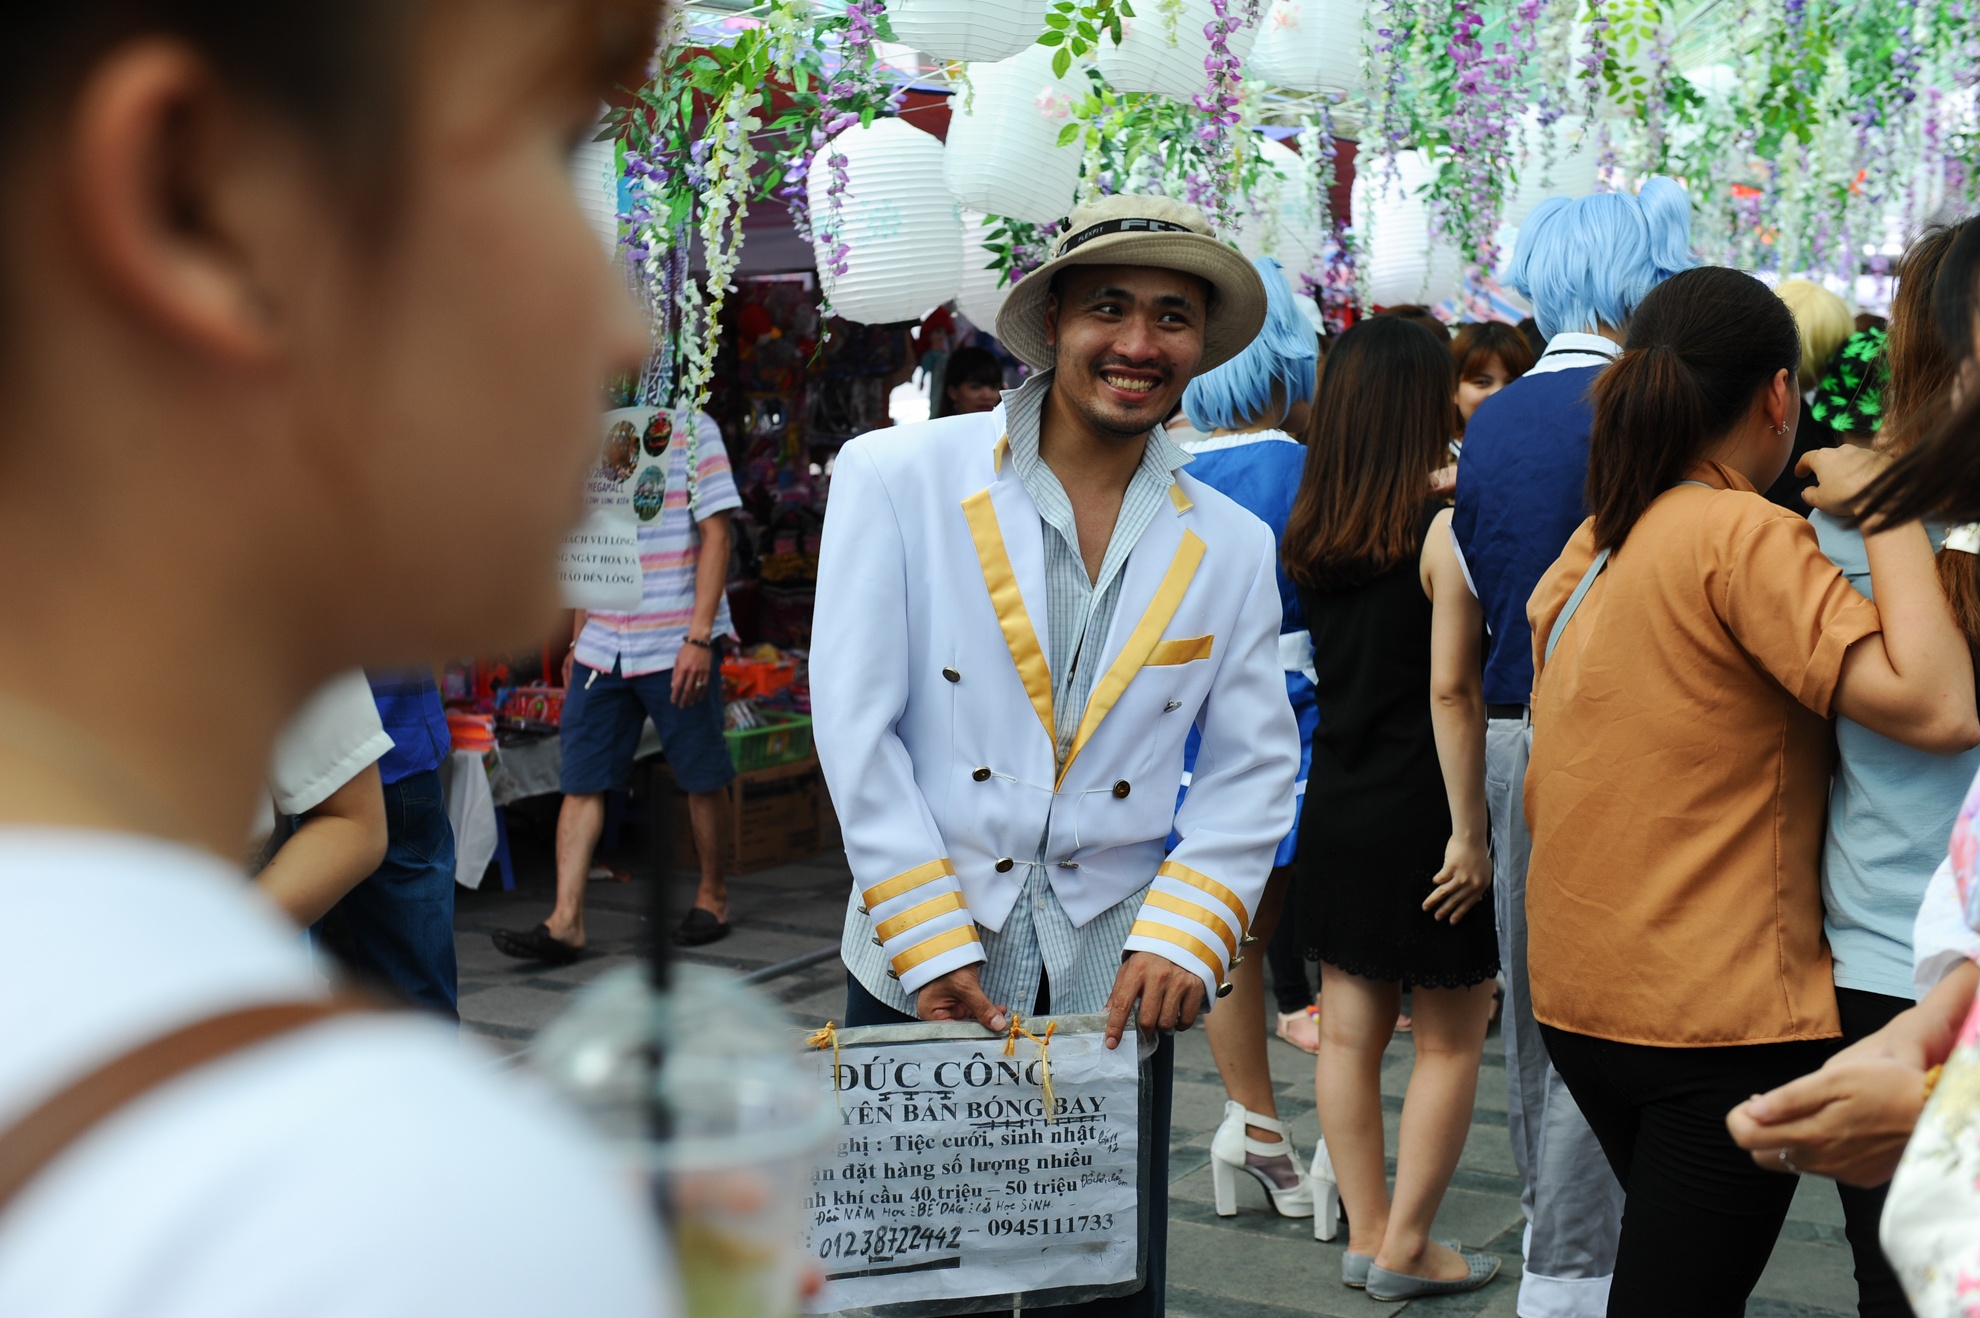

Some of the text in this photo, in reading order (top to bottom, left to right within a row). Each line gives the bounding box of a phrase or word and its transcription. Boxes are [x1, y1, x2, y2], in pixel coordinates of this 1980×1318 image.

[1077, 226, 1104, 243] FLEXFIT
[600, 555, 622, 565] HOA
[830, 1052, 1055, 1091] ĐỨC CÔNG
[840, 1094, 1107, 1125] YÊN BÁN BÓNG BAY
[837, 1136, 869, 1157] ghị
[890, 1134, 936, 1155] Tiệc
[942, 1130, 994, 1149] cưới,
[1001, 1128, 1043, 1146] sinh
[1051, 1125, 1097, 1145] nhật
[810, 1148, 1093, 1186] ận đặt hàng số lượng nhiều
[803, 1191, 827, 1210] nh
[833, 1189, 865, 1206] khí
[870, 1185, 904, 1204] cầu
[910, 1186, 932, 1202] 40
[938, 1183, 982, 1202] triệu
[1005, 1180, 1027, 1196] 50
[1033, 1177, 1077, 1197] triệu
[819, 1225, 962, 1259] 01238722442
[988, 1213, 1114, 1237] 0945111733
